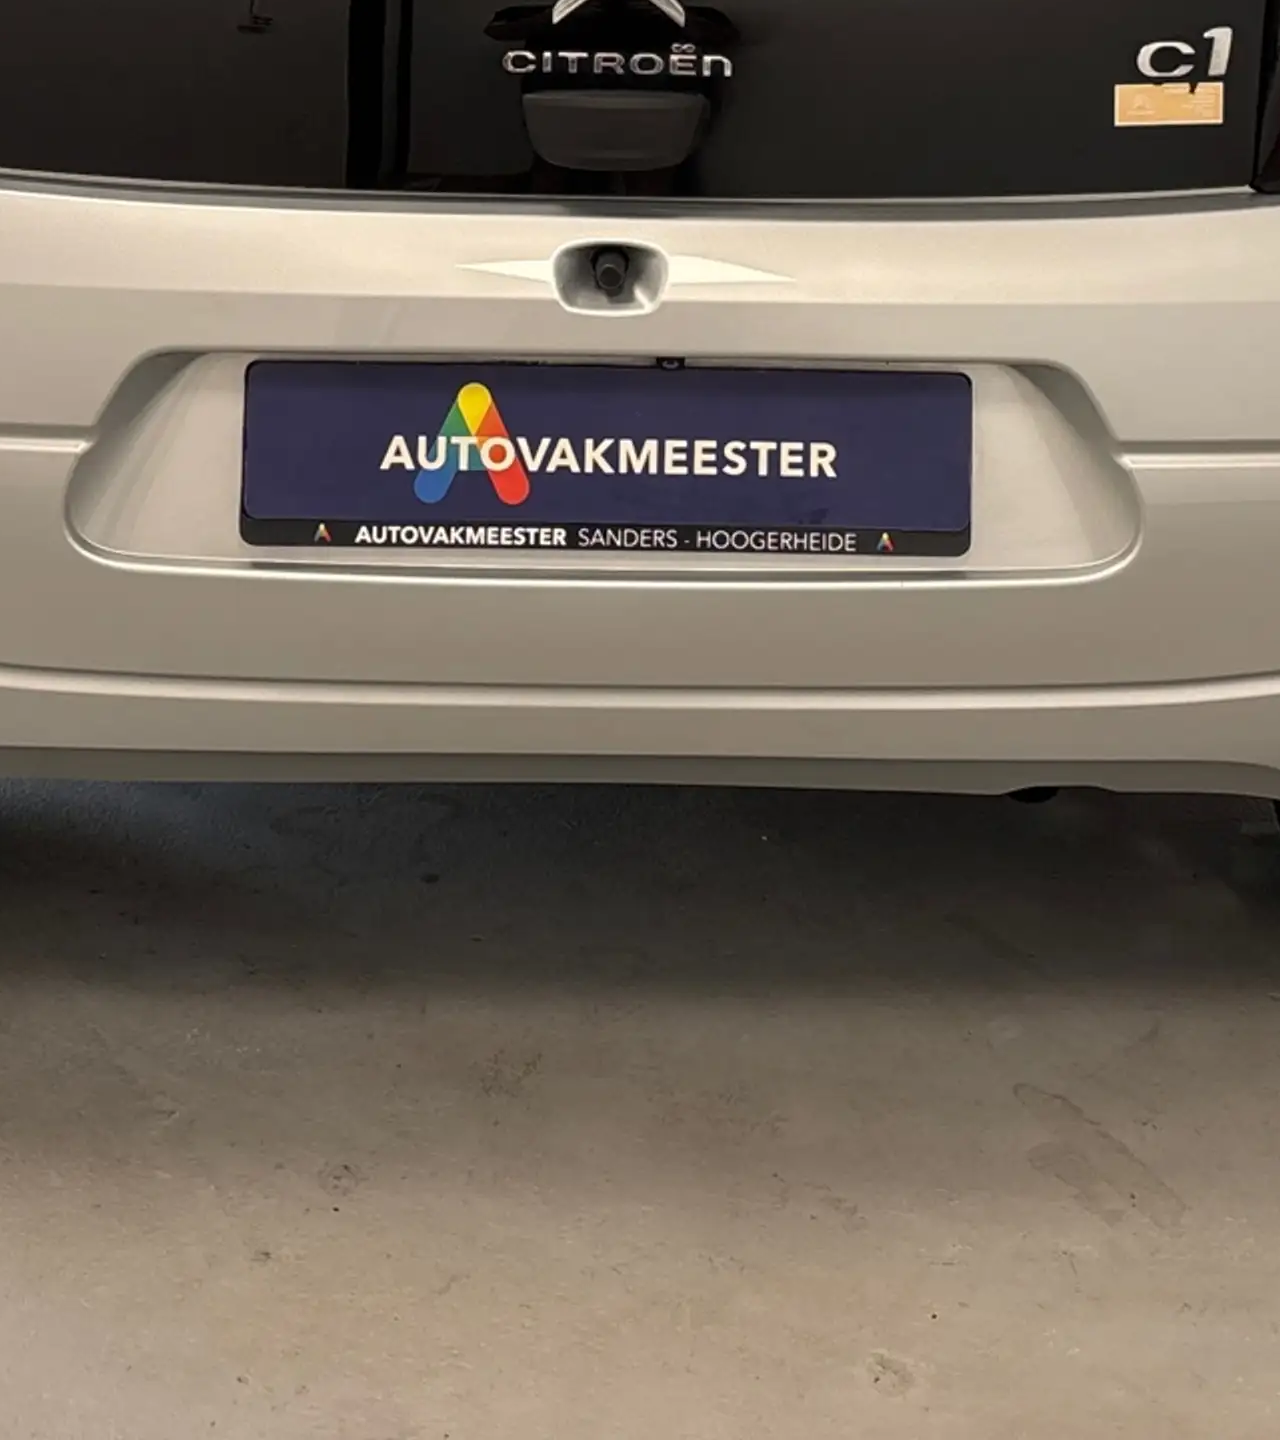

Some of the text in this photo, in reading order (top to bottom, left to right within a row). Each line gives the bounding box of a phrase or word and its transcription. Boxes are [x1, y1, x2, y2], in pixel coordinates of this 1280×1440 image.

[1136, 26, 1233, 78] C1
[379, 434, 838, 479] AUTOVAKMEESTER
[354, 525, 567, 547] AUTOVAKMEESTER
[577, 528, 678, 549] SANDERS
[695, 530, 858, 552] HOOGERHEIDE
